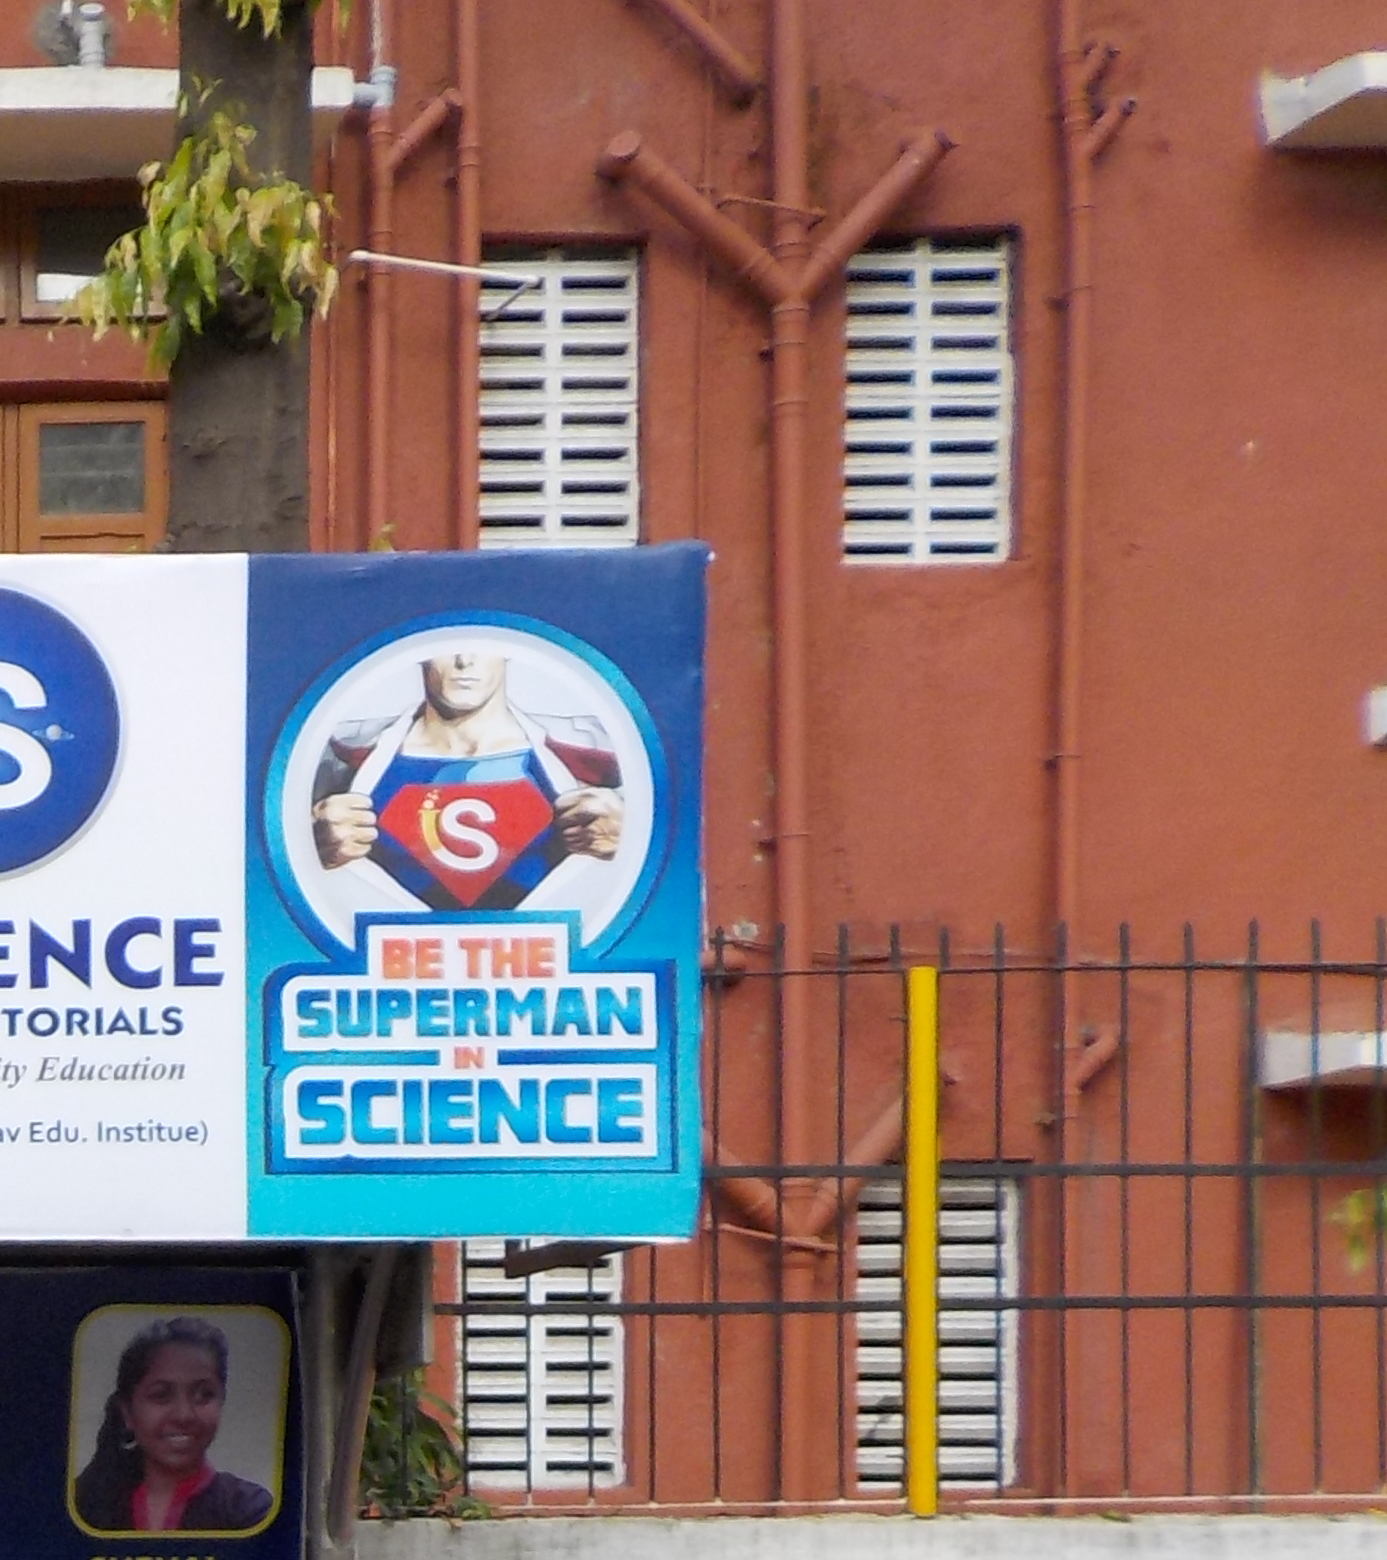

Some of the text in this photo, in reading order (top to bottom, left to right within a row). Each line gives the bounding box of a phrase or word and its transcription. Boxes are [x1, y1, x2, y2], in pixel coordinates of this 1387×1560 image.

[380, 937, 556, 980] BE THE
[295, 987, 643, 1037] SUPERMAN
[36, 1055, 187, 1083] Education
[453, 1047, 485, 1069] IN
[297, 1078, 643, 1145] SCIENCE
[28, 1121, 88, 1146] Edu.
[96, 1120, 209, 1148] Institue)
